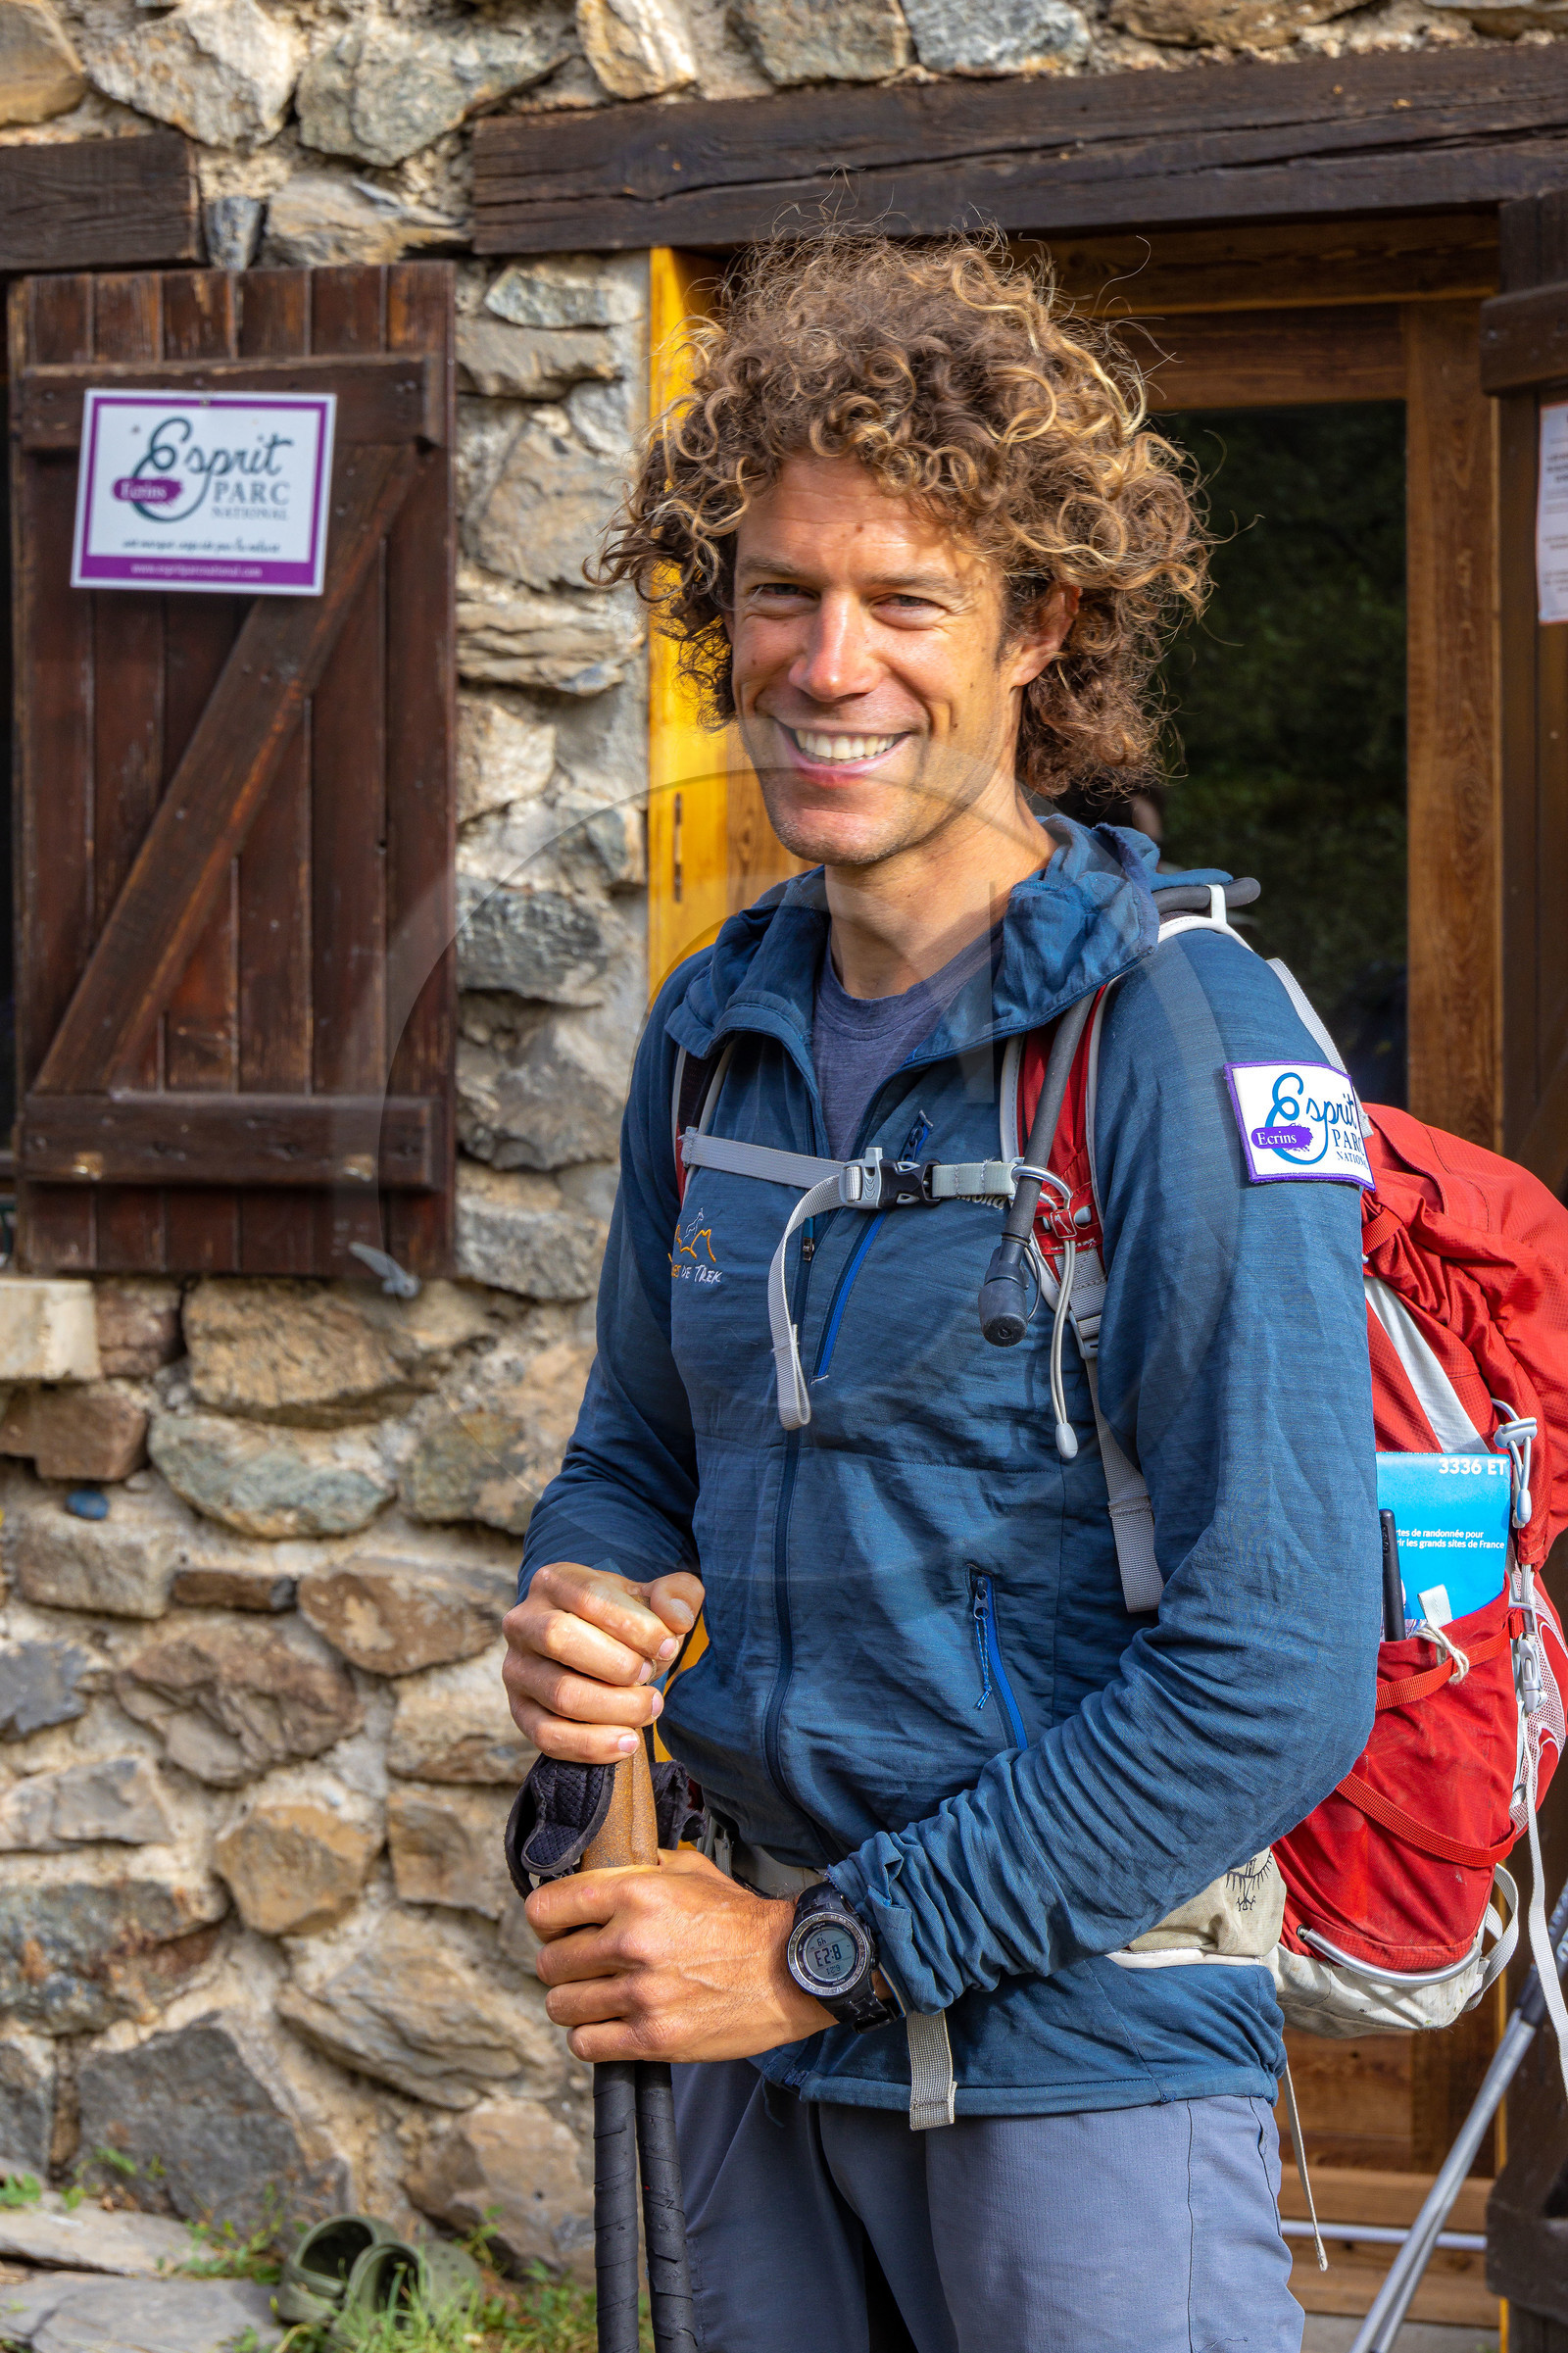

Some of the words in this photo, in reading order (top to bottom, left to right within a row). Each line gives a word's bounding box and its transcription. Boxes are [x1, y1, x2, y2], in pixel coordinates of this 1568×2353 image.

[131, 416, 293, 512] Esprit
[213, 479, 291, 506] PARC
[1265, 1072, 1357, 1156] Esprit
[1256, 1131, 1298, 1146] Ecrins
[1331, 1128, 1364, 1156] PARC
[695, 1264, 722, 1284] TREK
[1438, 1457, 1482, 1475] 3336
[1487, 1458, 1507, 1476] ET
[1406, 1539, 1418, 1547] les
[1419, 1539, 1446, 1549] grands
[1447, 1540, 1466, 1548] sites
[1468, 1540, 1478, 1548] de
[1479, 1540, 1505, 1549] France
[1411, 1529, 1421, 1538] de
[1423, 1529, 1464, 1539] randonnée
[1465, 1531, 1484, 1541] pour
